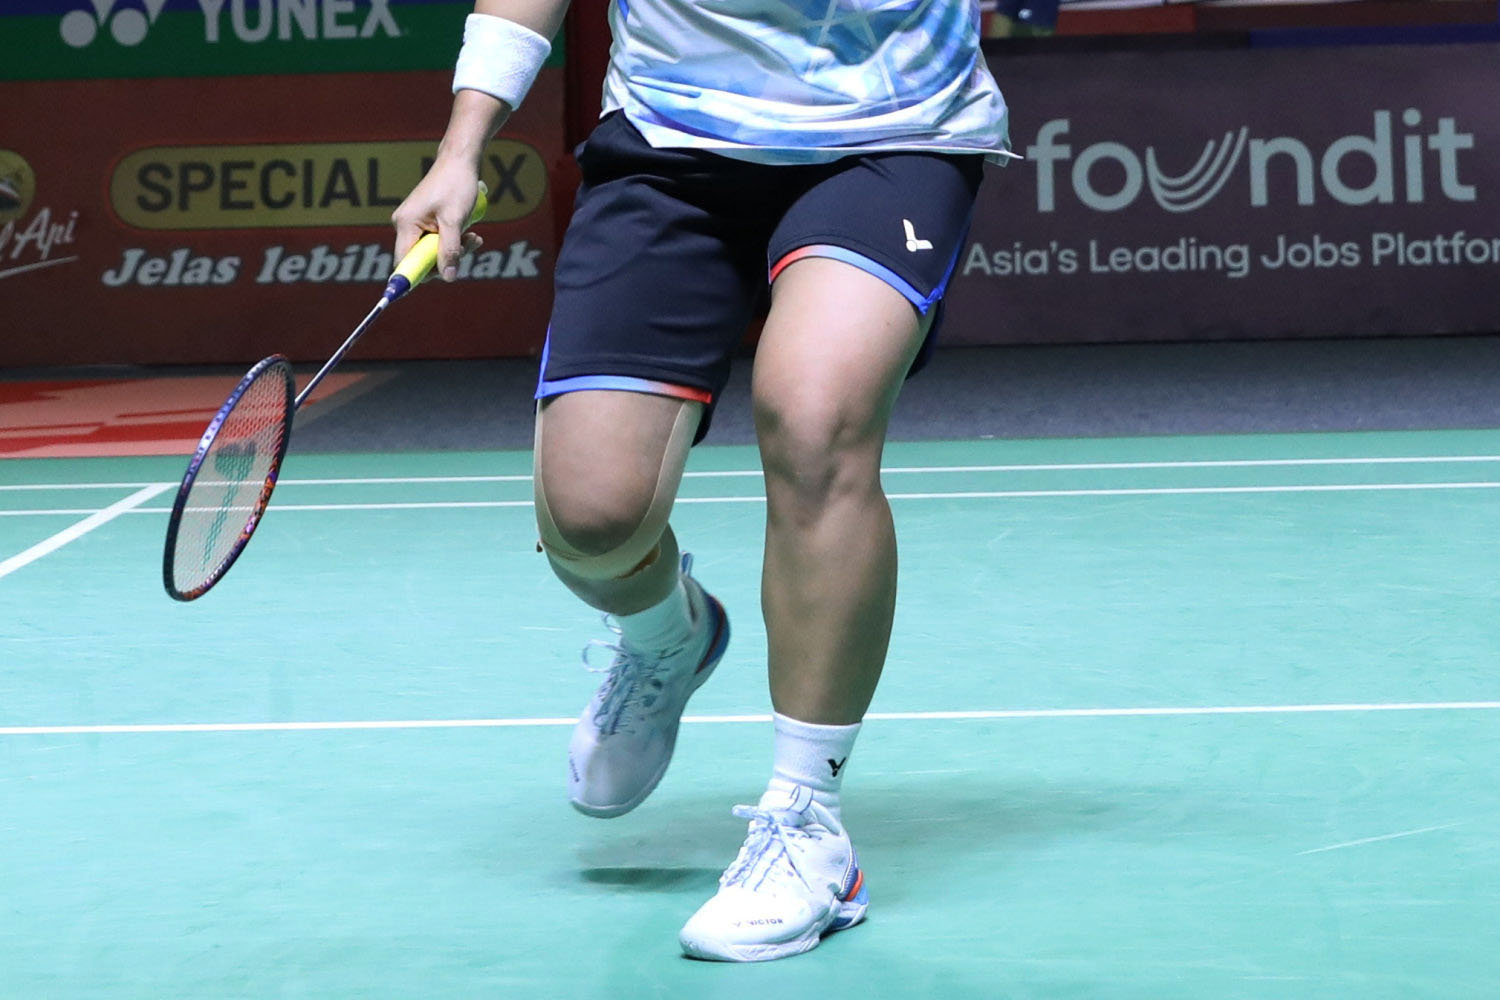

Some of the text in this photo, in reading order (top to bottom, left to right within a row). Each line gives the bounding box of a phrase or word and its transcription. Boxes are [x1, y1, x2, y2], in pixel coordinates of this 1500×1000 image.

[136, 157, 399, 212] SPECIAL
[1026, 107, 1478, 213] foundit
[102, 247, 242, 287] Jelas
[256, 242, 394, 285] lebih
[1089, 235, 1250, 278] Leading
[1260, 232, 1361, 270] Jobs
